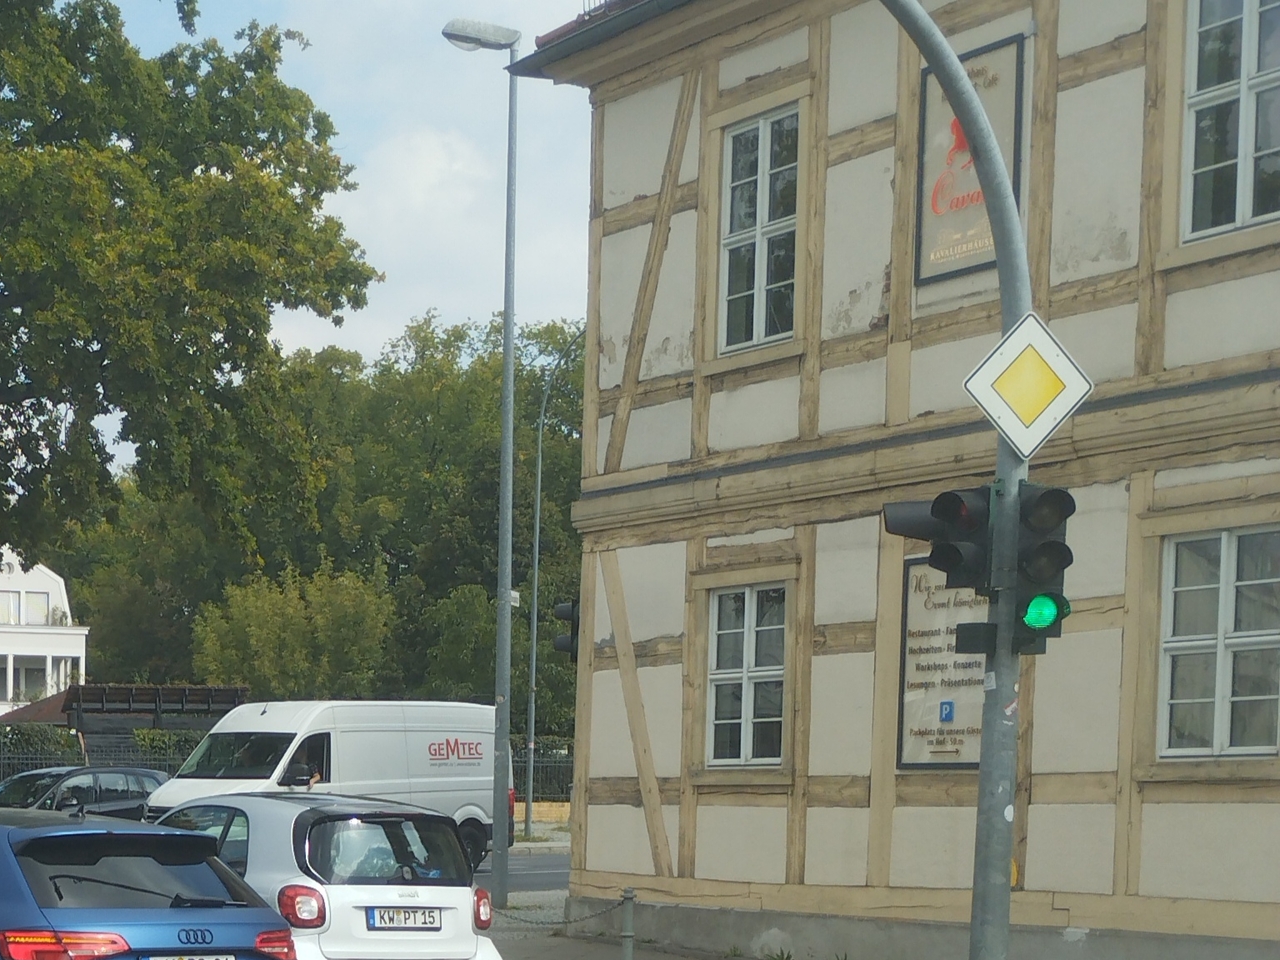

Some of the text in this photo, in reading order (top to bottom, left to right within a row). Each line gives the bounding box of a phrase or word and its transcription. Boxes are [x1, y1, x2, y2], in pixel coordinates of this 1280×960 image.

[907, 628, 941, 638] Restaurant
[915, 660, 982, 673] Workshops Konzerte
[428, 738, 483, 760] GEMTEC
[379, 910, 395, 925] KW
[403, 910, 418, 925] PT
[421, 910, 436, 925] 15
